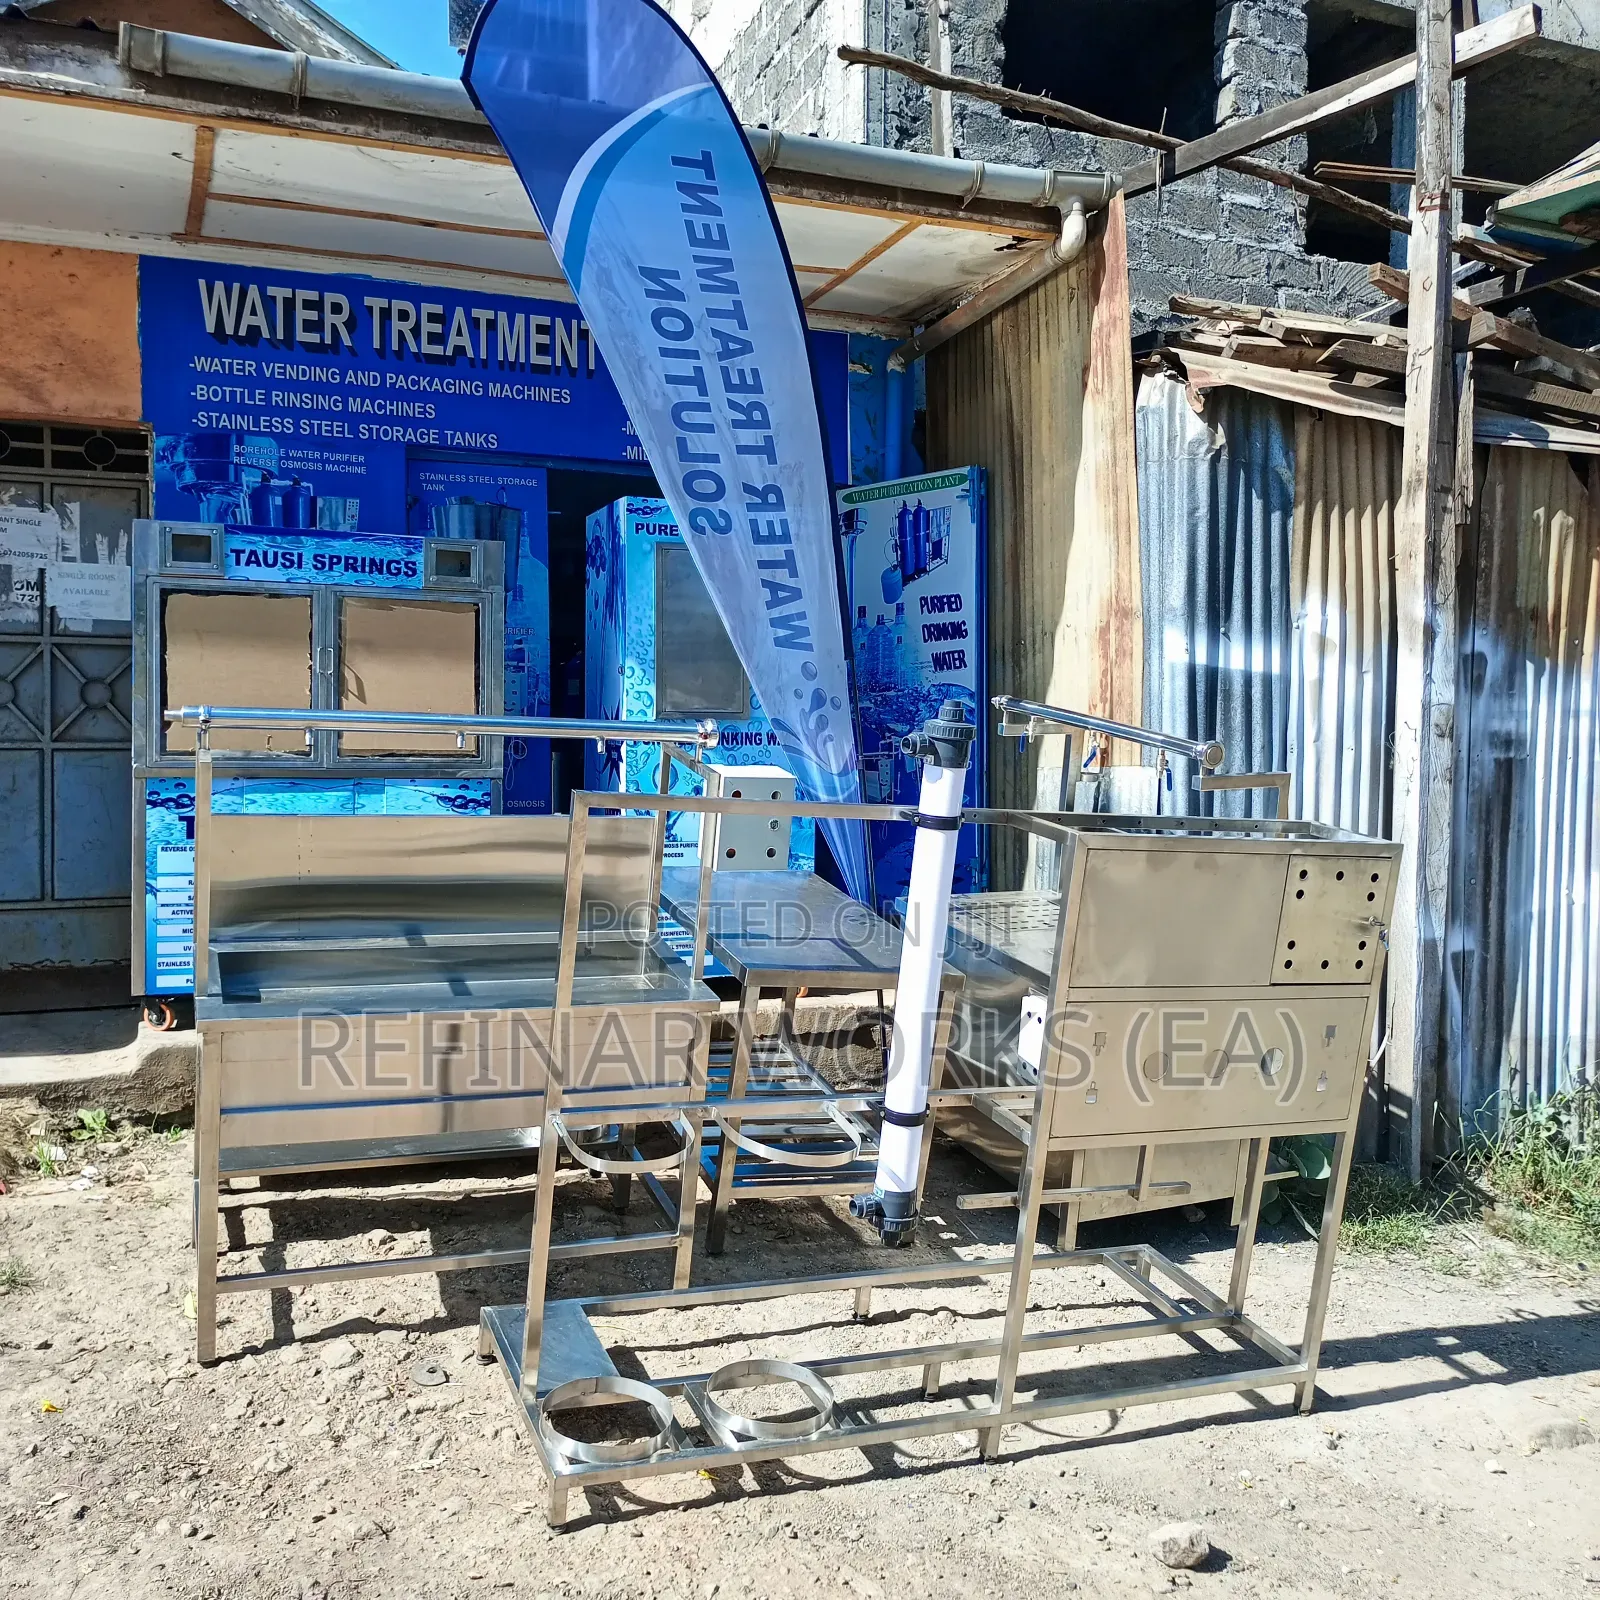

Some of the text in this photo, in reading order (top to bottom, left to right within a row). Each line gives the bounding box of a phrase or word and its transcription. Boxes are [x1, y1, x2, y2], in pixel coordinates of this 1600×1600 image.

[198, 278, 596, 370] WATER TREATMENT
[188, 355, 572, 405] -WATER VENDING AND PACKAGING MACHINES
[190, 384, 436, 420] -BOTTLE RINSING MACHINES
[191, 411, 499, 450] -STAINLESS STEEL STORAGE TANKS
[233, 445, 366, 463] BOREHOLE WATER PURIFIER
[233, 456, 367, 475] REVERSE OSMOSIS MACHINE
[419, 472, 538, 487] STAINLESS STEEL STORAGE
[422, 484, 446, 492] TANK
[852, 474, 961, 502] WATER PURIFICATION PLANT
[16, 518, 42, 527] SINGLE
[230, 547, 418, 578] TAUSI SPRINGS
[63, 587, 111, 596] AVAILABLE
[919, 593, 963, 615] PURIFIED
[922, 620, 968, 643] DRINKING
[931, 649, 968, 672] WATER
[507, 800, 545, 808] OSMOSIS
